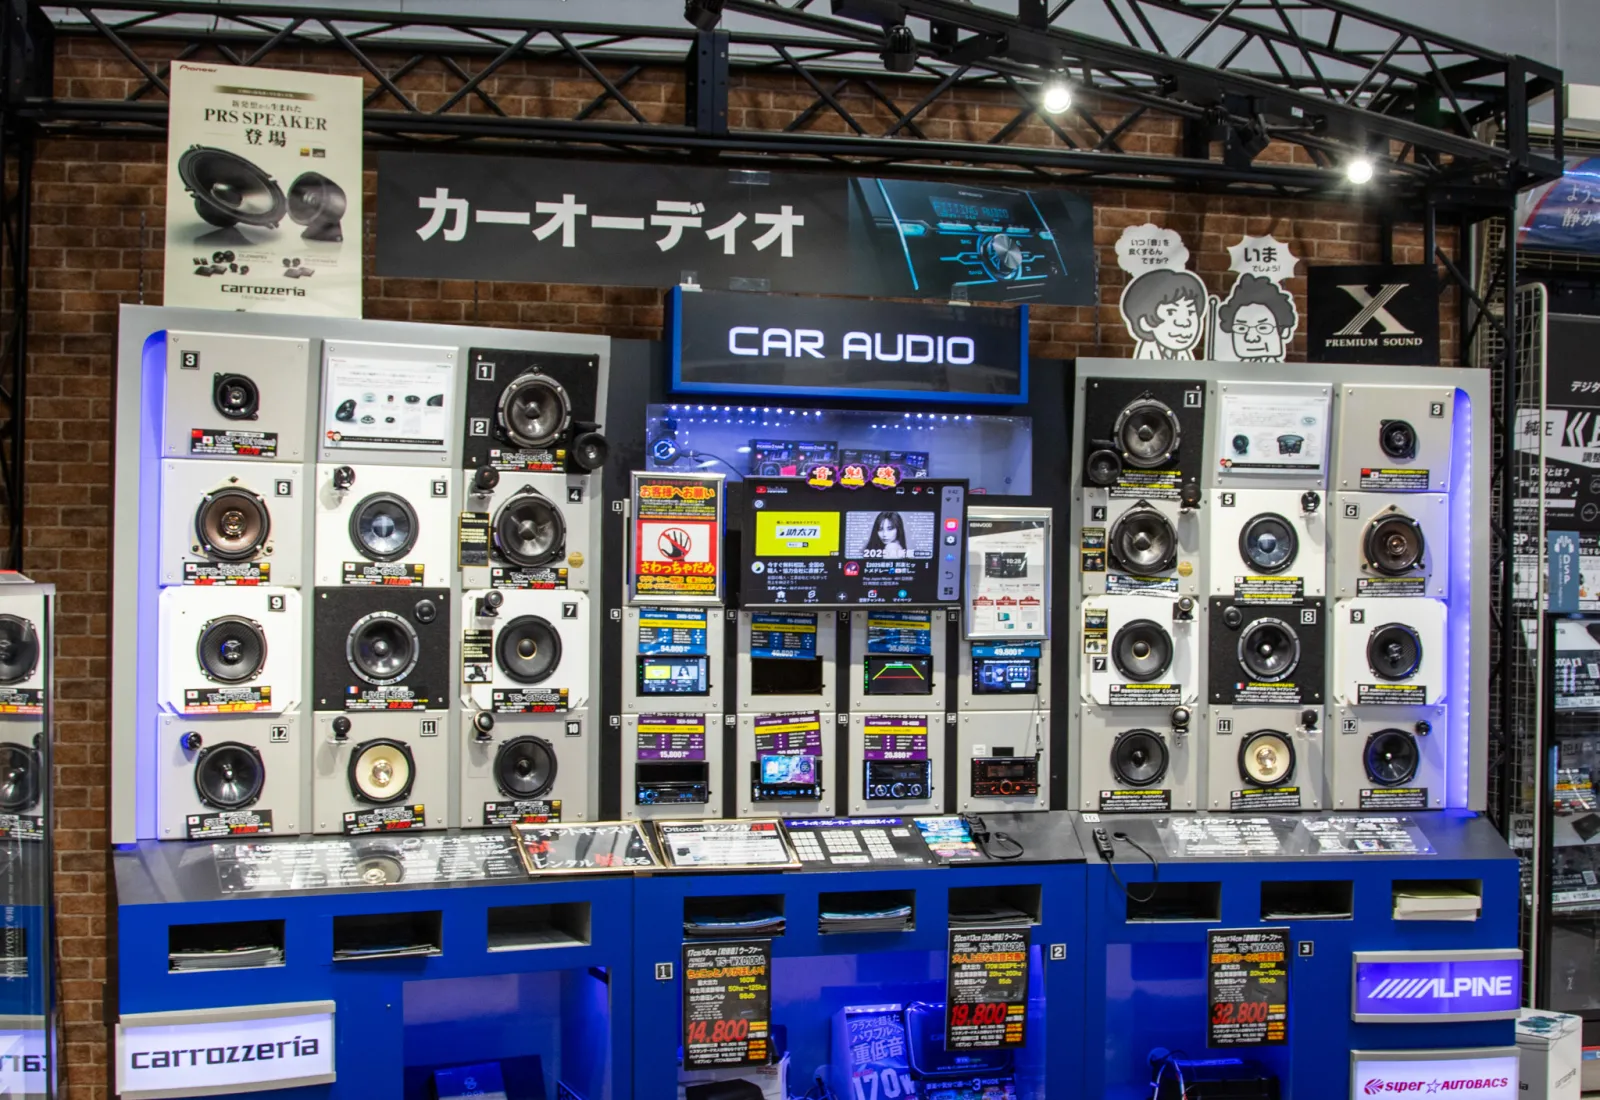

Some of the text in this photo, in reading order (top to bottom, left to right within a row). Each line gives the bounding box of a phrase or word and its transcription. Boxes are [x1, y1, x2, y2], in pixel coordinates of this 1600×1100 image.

[204, 108, 328, 131] PRS SPEAKER
[245, 128, 287, 147] 登場
[415, 187, 805, 258] カーオーディオ
[1244, 246, 1277, 263] いま
[220, 284, 307, 297] carrozzeria
[1332, 283, 1415, 335] X
[728, 326, 975, 365] CAR AUDIO
[1325, 337, 1423, 348] PREMIUM SOUND
[185, 354, 195, 366] 3
[481, 366, 488, 378] 1
[1433, 404, 1441, 414] 3
[475, 422, 485, 433] 2
[278, 483, 288, 494] 6
[435, 483, 444, 494] 5
[570, 490, 579, 501] 4
[1224, 494, 1233, 504] 5
[1095, 509, 1104, 519] 4
[1346, 505, 1356, 516] 6
[641, 561, 715, 574] さわっちゃだめ
[272, 597, 282, 608] 9
[566, 605, 574, 616] 7
[1304, 611, 1313, 621] 8
[1353, 611, 1361, 621] 9
[1096, 659, 1104, 669] 7
[423, 722, 434, 734] 11
[568, 723, 578, 733] 10
[1219, 720, 1231, 731] 11
[1343, 721, 1356, 731] 12
[273, 727, 287, 740] 12
[539, 825, 634, 837] オットキャスト
[1054, 947, 1063, 957] 2
[1302, 944, 1310, 953] 3
[660, 966, 666, 978] 1
[1402, 976, 1513, 998] ALPINE
[851, 1014, 900, 1032] クラスを超えた
[131, 1036, 319, 1070] carrozzeria
[853, 1036, 904, 1065] 重低音
[1440, 1077, 1508, 1090] AUTOBACS
